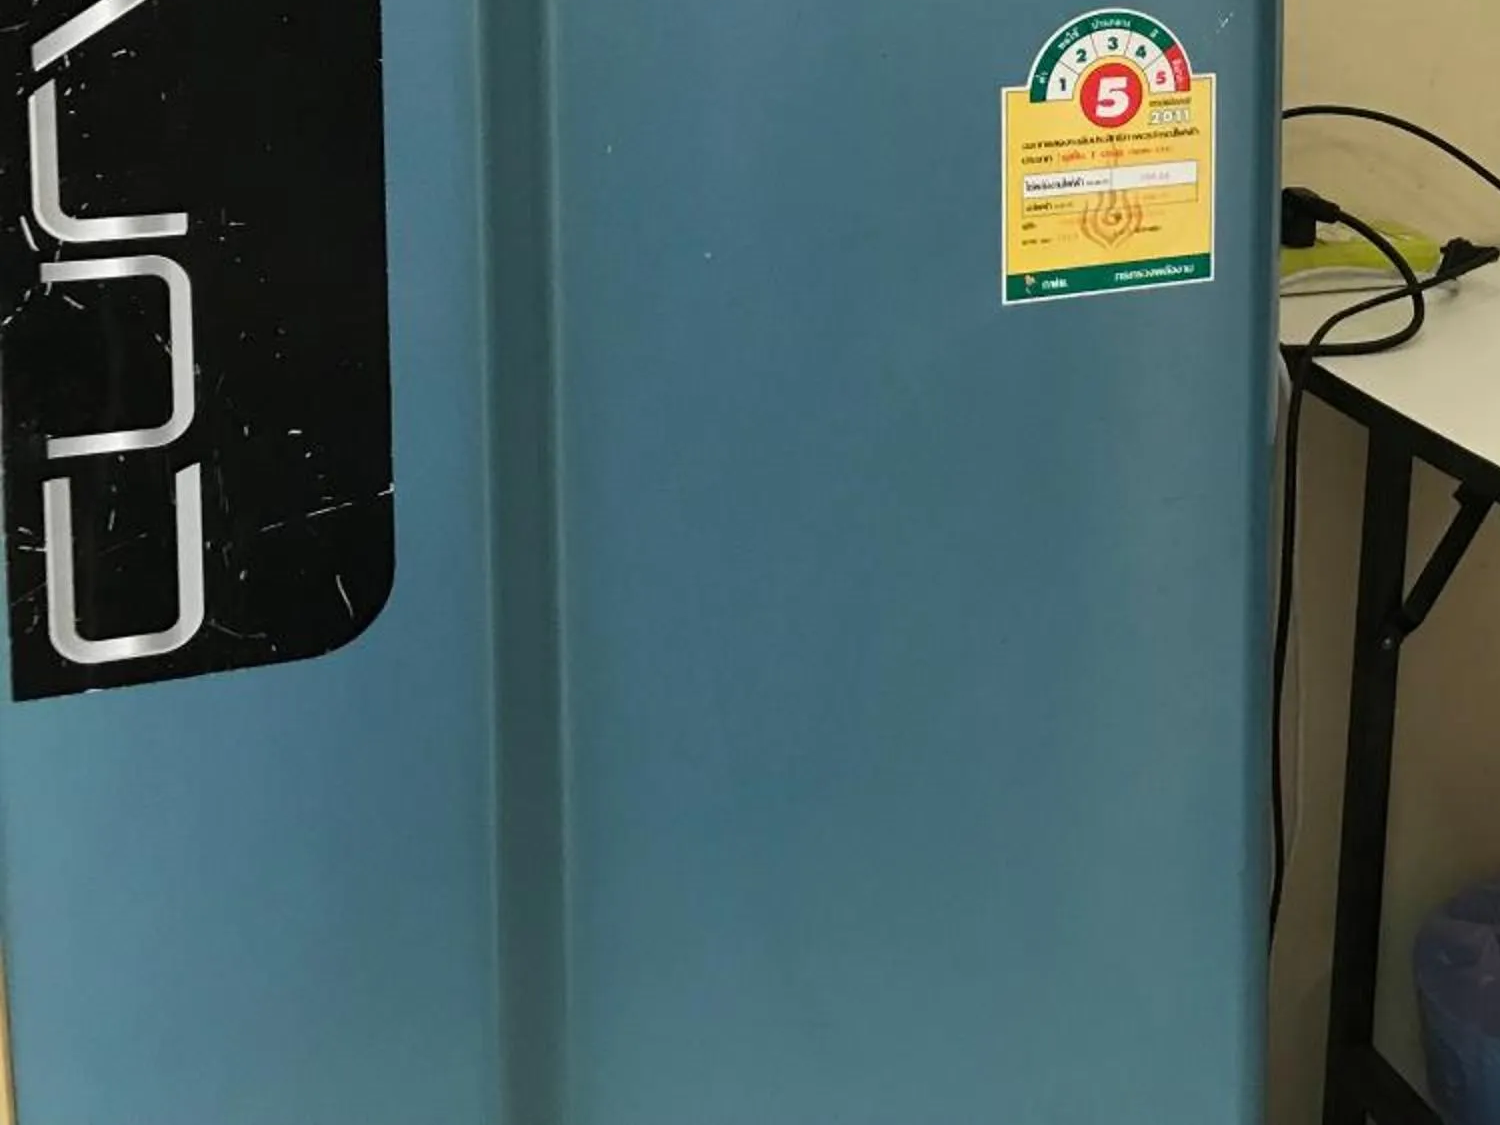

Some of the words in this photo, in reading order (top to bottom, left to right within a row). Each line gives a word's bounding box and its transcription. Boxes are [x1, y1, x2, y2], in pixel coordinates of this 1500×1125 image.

[1107, 37, 1119, 51] 3
[1075, 48, 1088, 63] 2
[1135, 44, 1147, 60] 4
[1059, 77, 1066, 92] 1
[1155, 72, 1167, 84] 5
[1095, 76, 1129, 119] 5
[1151, 110, 1191, 125] 2011
